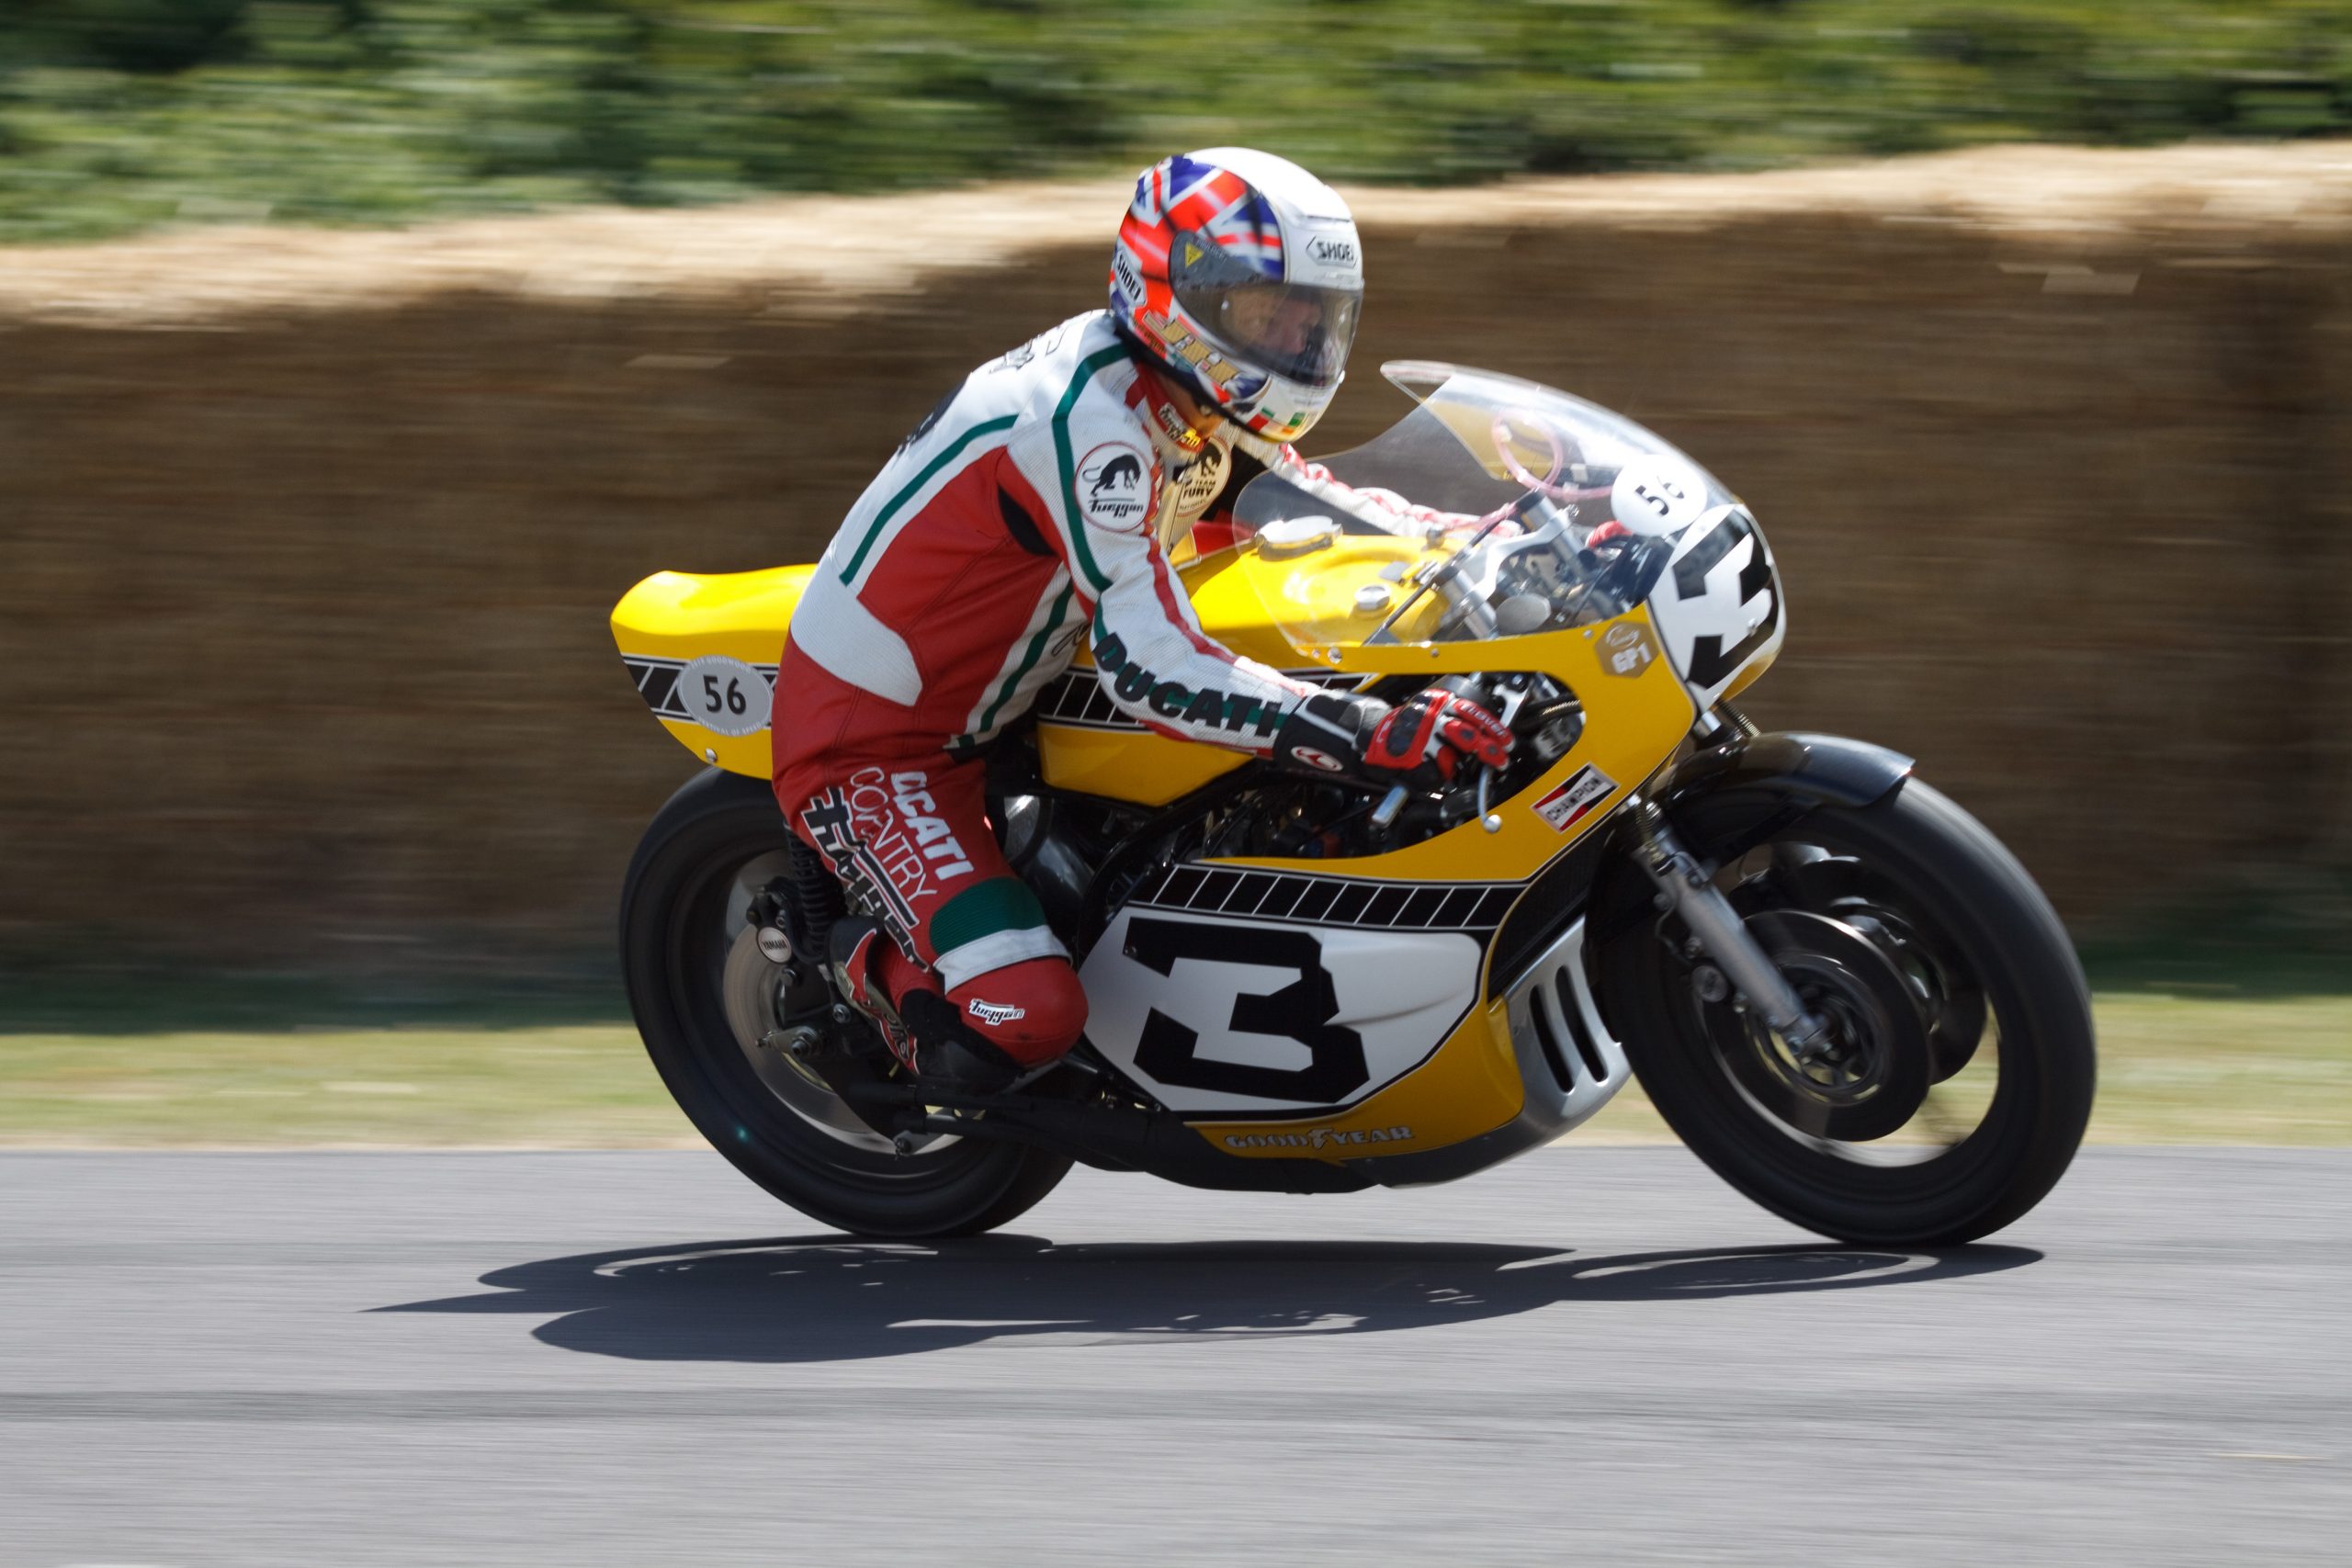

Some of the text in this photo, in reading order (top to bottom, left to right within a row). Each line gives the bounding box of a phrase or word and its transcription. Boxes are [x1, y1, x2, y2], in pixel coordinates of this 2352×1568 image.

[1116, 254, 1142, 301] SHOEI
[1671, 508, 1780, 691] 3
[703, 674, 747, 716] 56
[1091, 631, 1283, 737] DUCATI
[891, 771, 975, 880] DCATI
[1545, 777, 1602, 821] CHAMPION
[762, 940, 789, 951] YAMAHA
[1121, 916, 1370, 1103] 3
